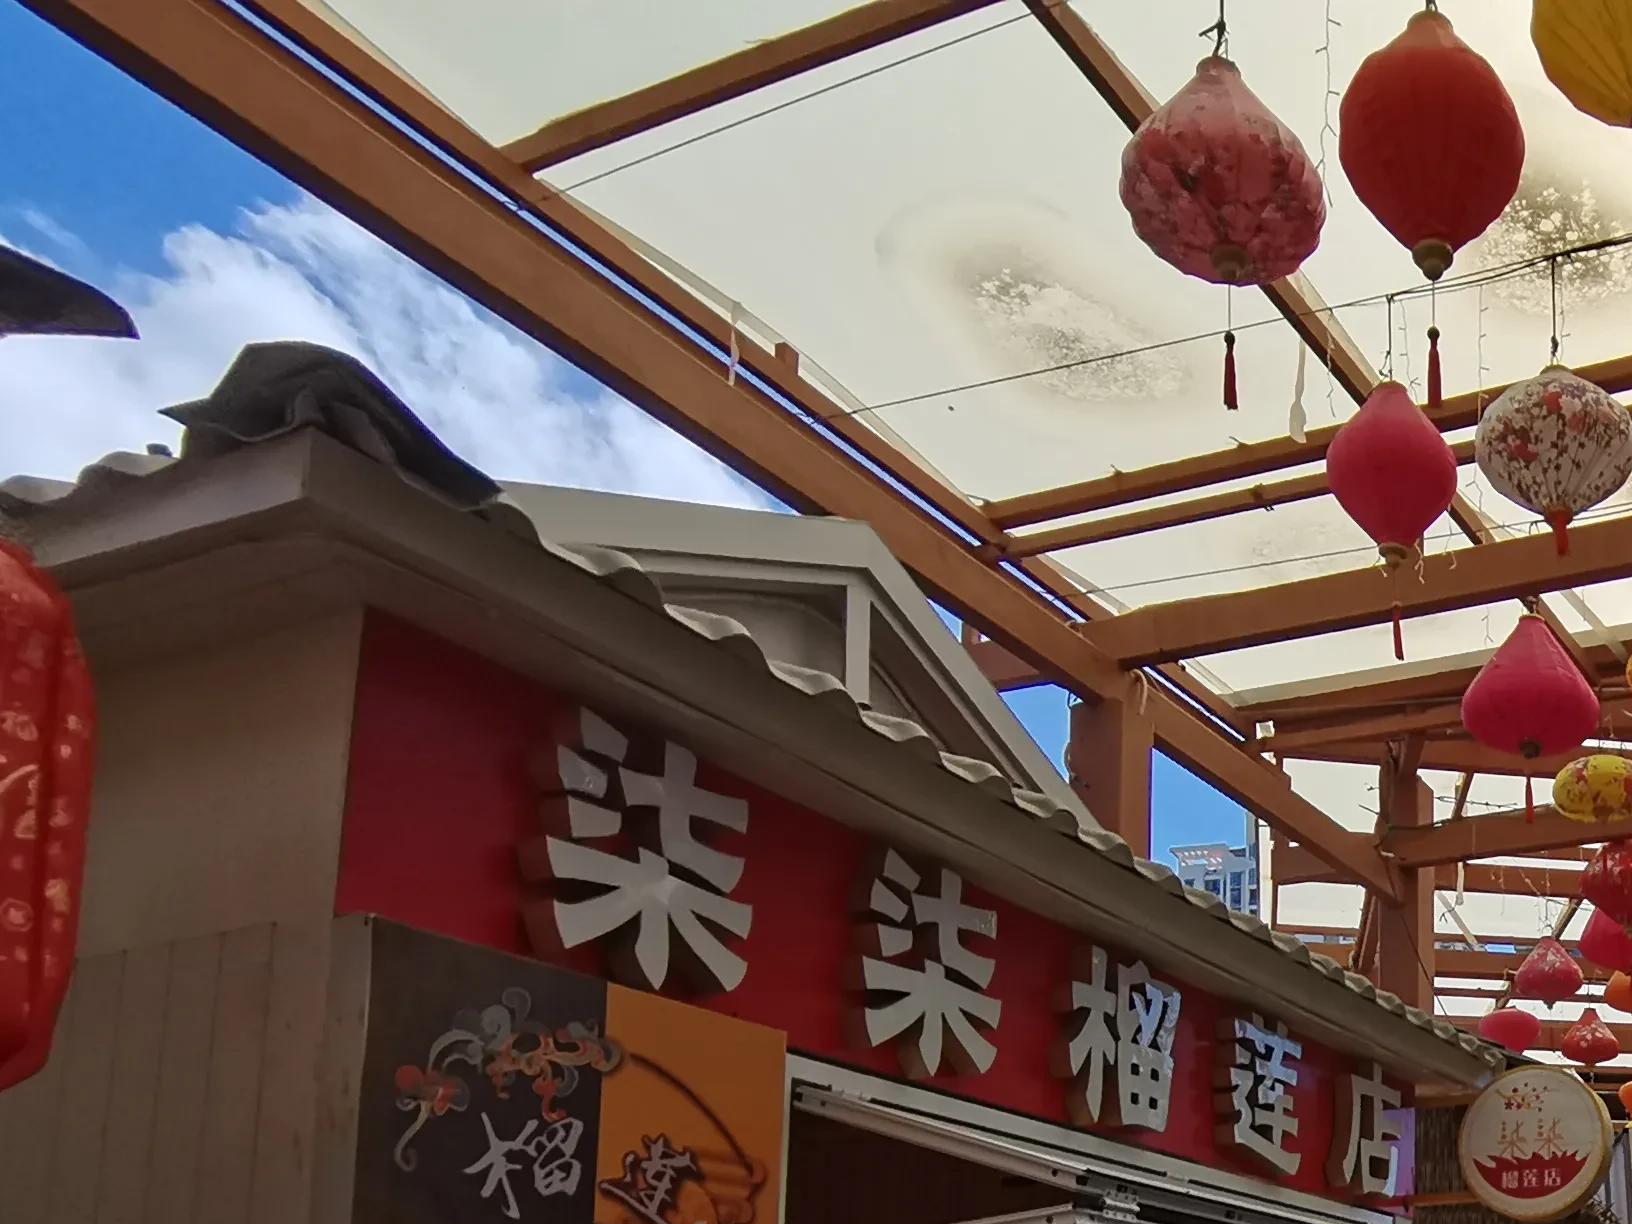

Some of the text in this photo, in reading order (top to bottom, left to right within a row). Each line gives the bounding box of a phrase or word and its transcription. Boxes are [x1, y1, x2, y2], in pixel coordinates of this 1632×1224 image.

[546, 706, 1402, 1198] 柒柒榴莲店
[1501, 1168, 1562, 1189] 榴莲店
